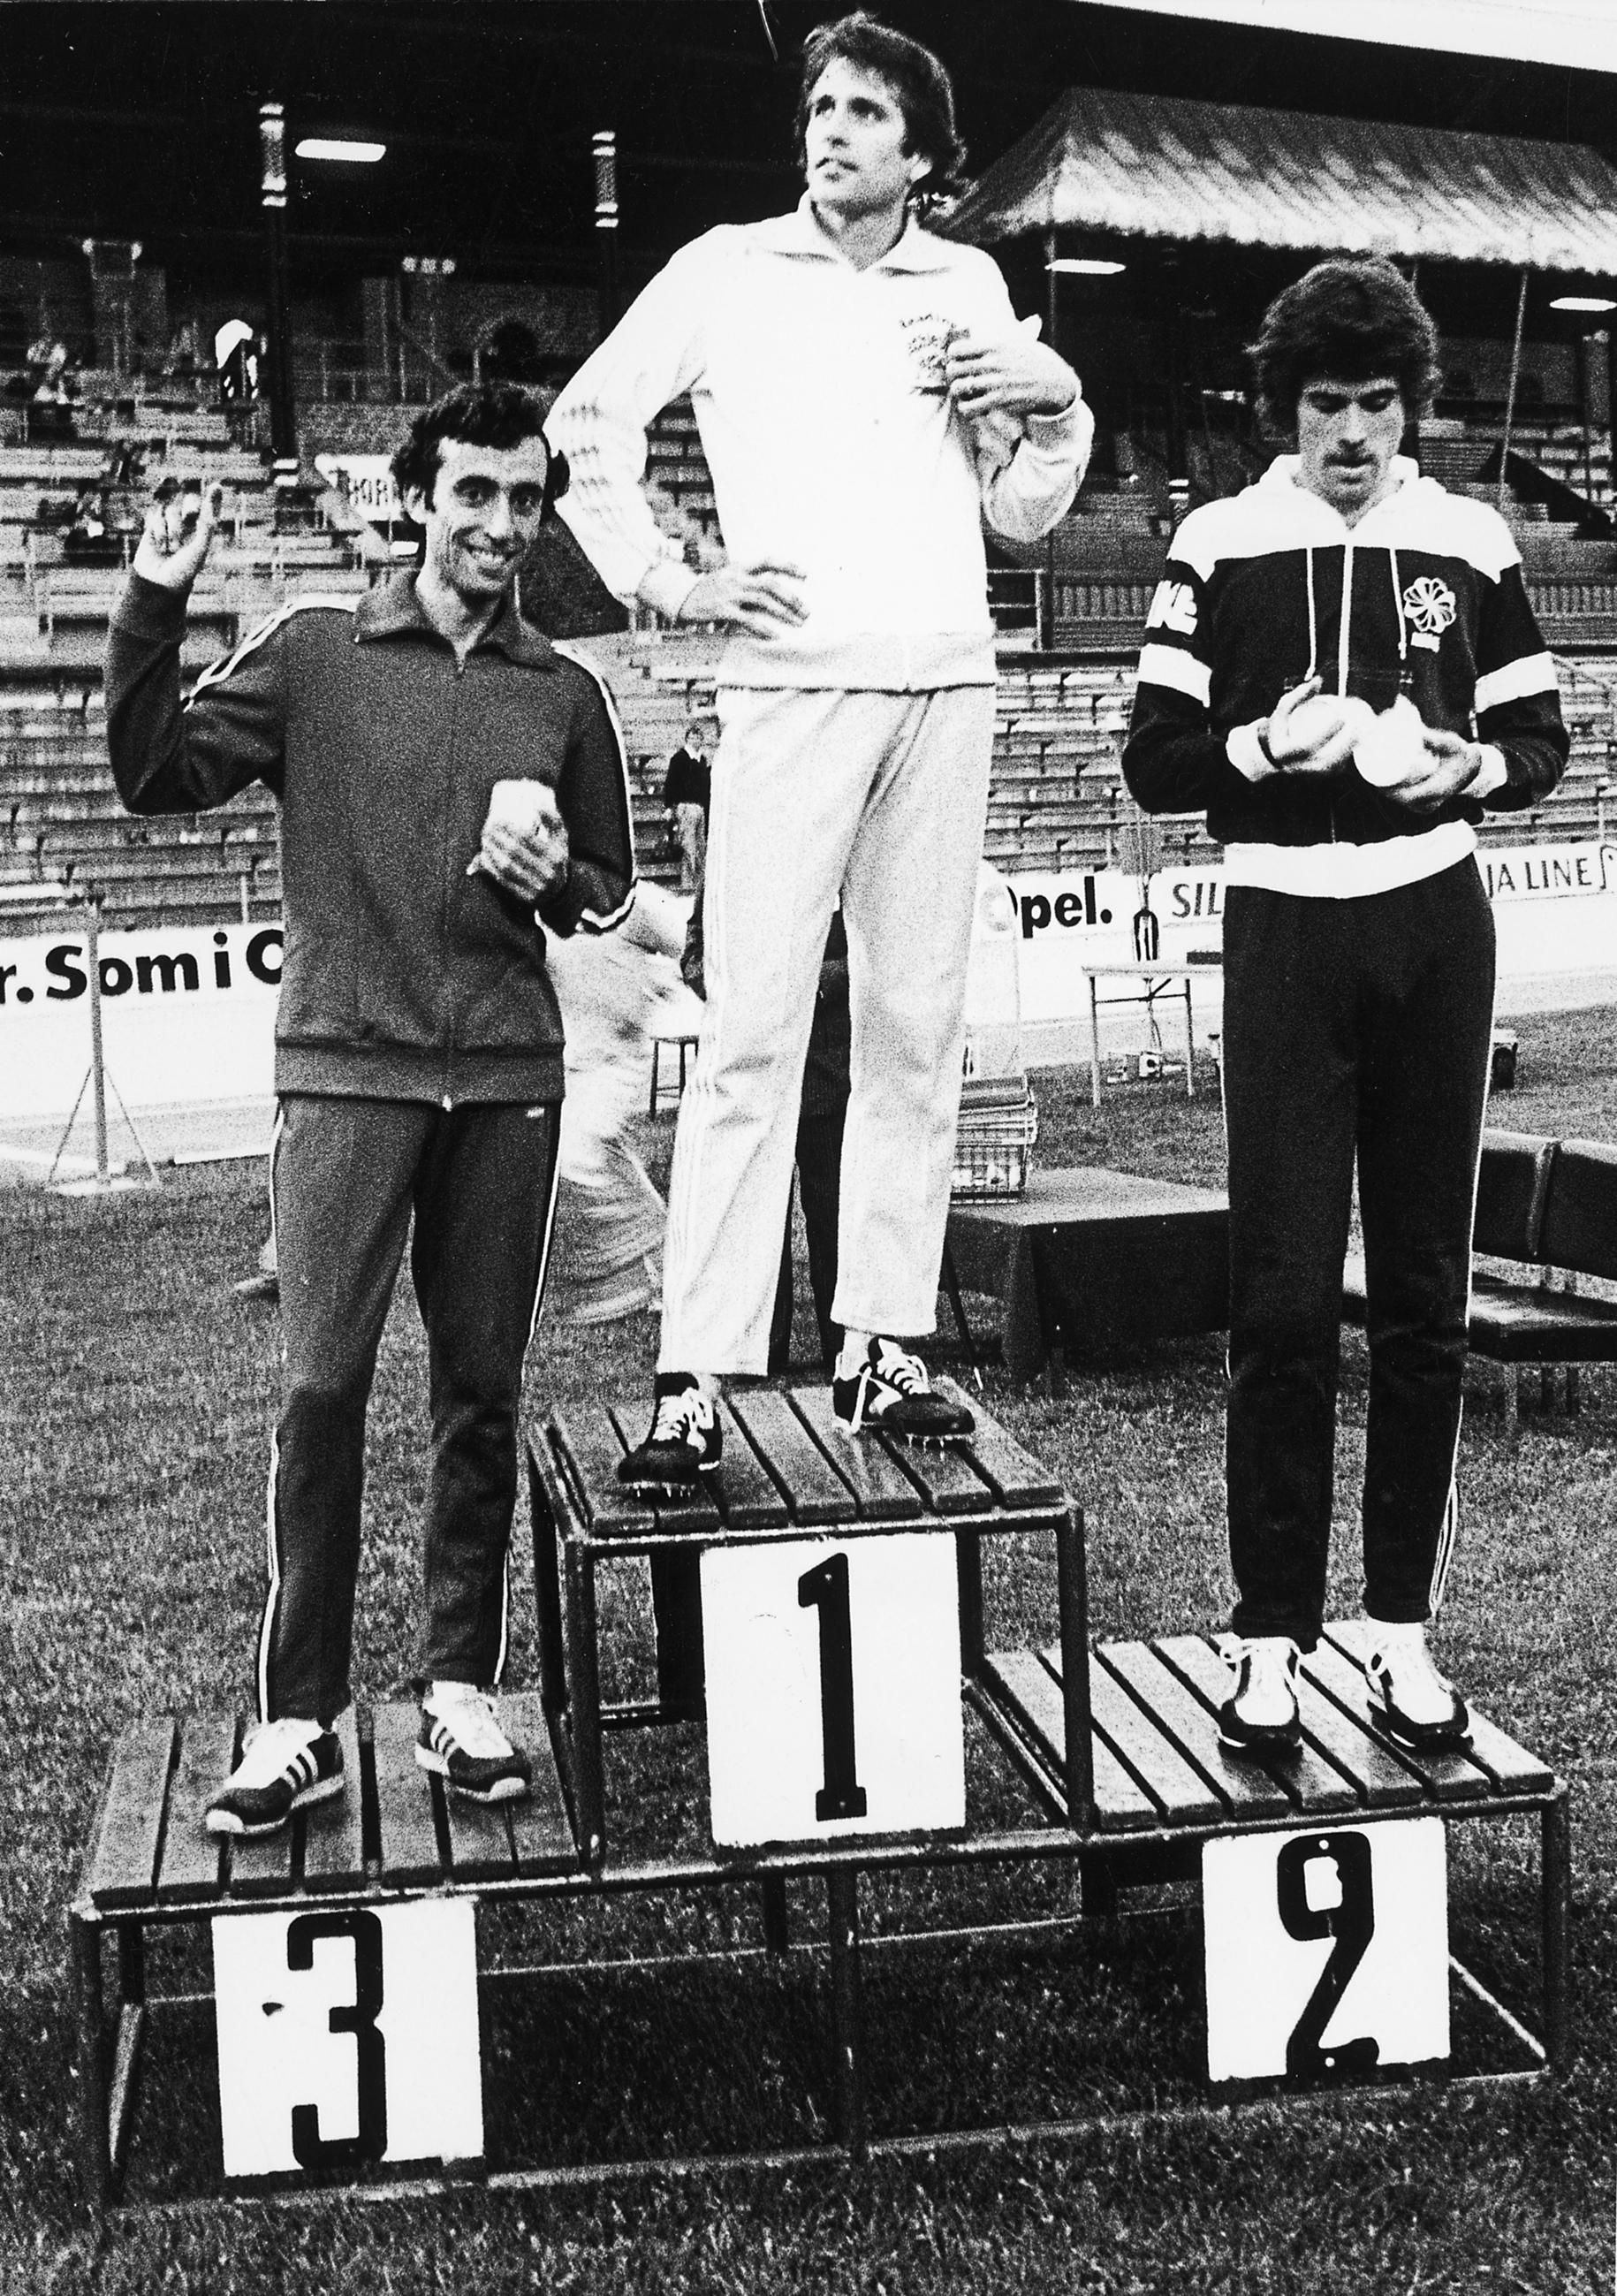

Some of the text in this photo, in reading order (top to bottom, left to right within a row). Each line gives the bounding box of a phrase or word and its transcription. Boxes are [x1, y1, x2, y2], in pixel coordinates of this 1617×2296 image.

[1006, 876, 1112, 939] pel.
[1172, 882, 1222, 918] SIL
[1524, 857, 1592, 890] LINE
[45, 944, 200, 1000] Som
[213, 931, 232, 988] i
[797, 1552, 868, 1822] 1
[1277, 1830, 1380, 2077] 2
[286, 1909, 388, 2167] 3
